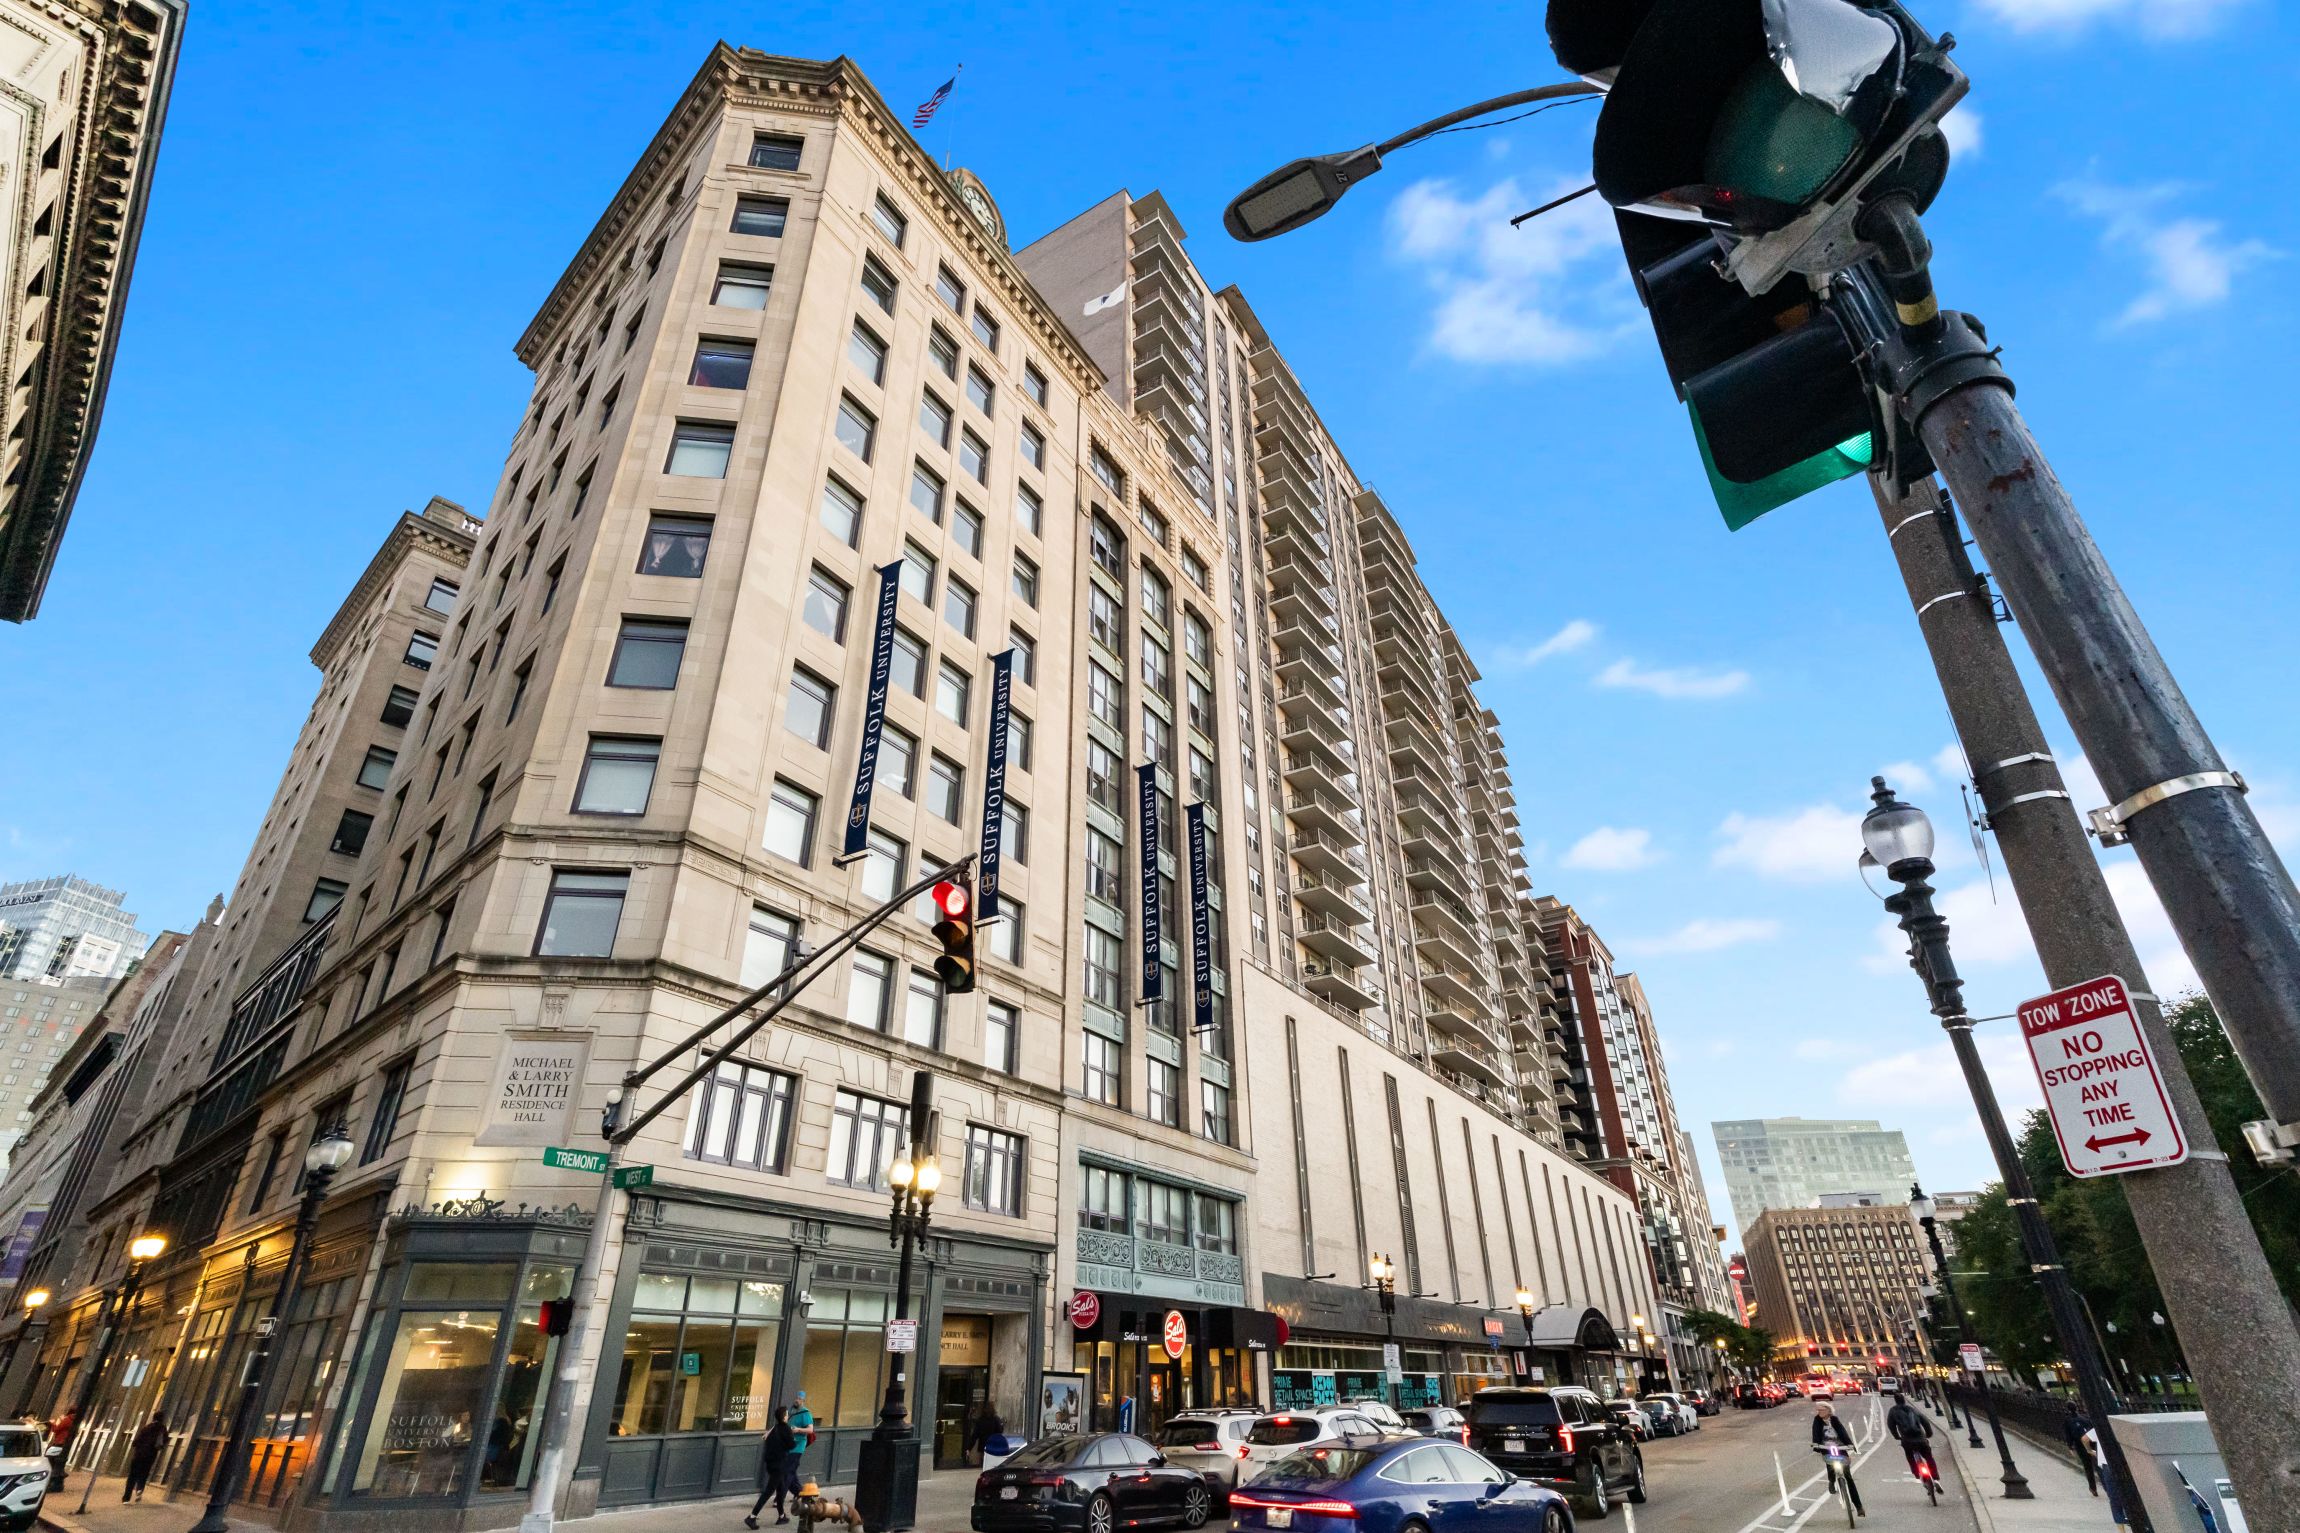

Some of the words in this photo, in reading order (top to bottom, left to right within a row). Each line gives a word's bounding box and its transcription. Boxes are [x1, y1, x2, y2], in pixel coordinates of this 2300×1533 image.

[857, 685, 885, 795] SUFFOLK
[876, 580, 896, 681] UNIVERSITY
[983, 763, 1003, 865] SUFFOLK
[994, 667, 1009, 760] UNIVERSITY
[1144, 780, 1156, 860] UNIVERSITY
[1193, 817, 1205, 895] UNIVERSITY
[1144, 864, 1157, 954] SUFFOLK
[1195, 898, 1208, 982] SUFFOLK
[2021, 1003, 2061, 1030] TOW
[2069, 985, 2123, 1017] ZONE
[2061, 1030, 2104, 1060] NO
[512, 1057, 575, 1069] MICHAEL
[2043, 1049, 2146, 1088] STOPPING
[508, 1070, 519, 1081] &
[523, 1070, 574, 1082] LARRY
[503, 1083, 570, 1098] SMITH
[2081, 1079, 2119, 1105] ANY
[500, 1099, 566, 1110] RESIDENCE
[513, 1112, 546, 1122] HALL
[2083, 1102, 2136, 1128] TIME
[555, 1151, 600, 1170] TREMONT
[599, 1163, 606, 1171] ST
[625, 1169, 642, 1185] WEST
[1071, 1295, 1095, 1316] Sal's
[1273, 1376, 1292, 1388] PRIME
[731, 1395, 764, 1404] SUFFOLK
[1274, 1389, 1294, 1402] RETAIL
[1294, 1388, 1313, 1401] SPACE
[390, 1415, 456, 1427] SUFFOLK
[1045, 1421, 1077, 1432] BROOKS
[383, 1437, 452, 1449] BOSTON
